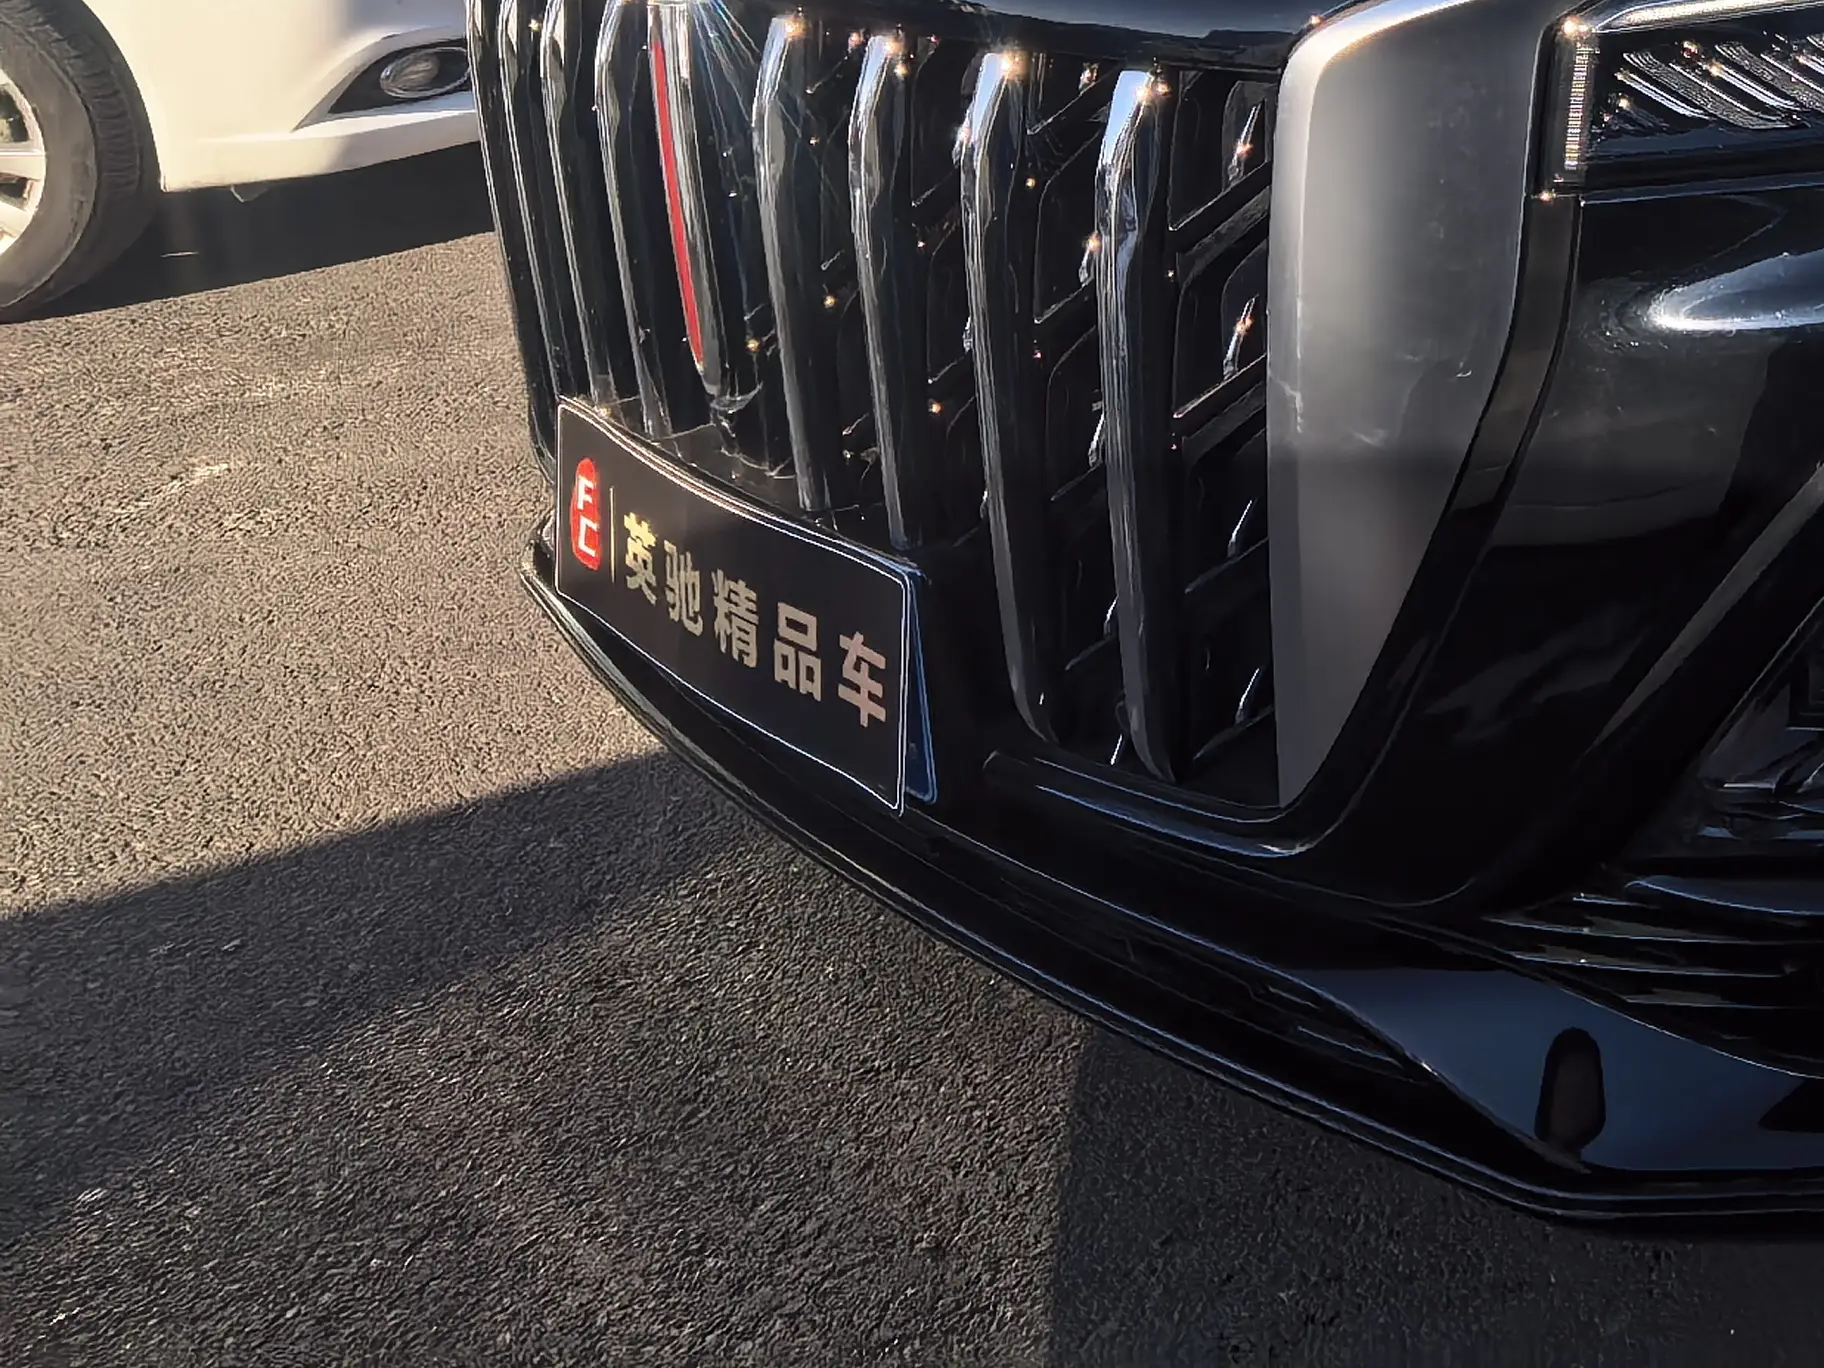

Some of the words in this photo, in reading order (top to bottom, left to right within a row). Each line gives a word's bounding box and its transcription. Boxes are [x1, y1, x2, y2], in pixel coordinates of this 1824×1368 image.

[623, 511, 887, 728] 英驰精品车
